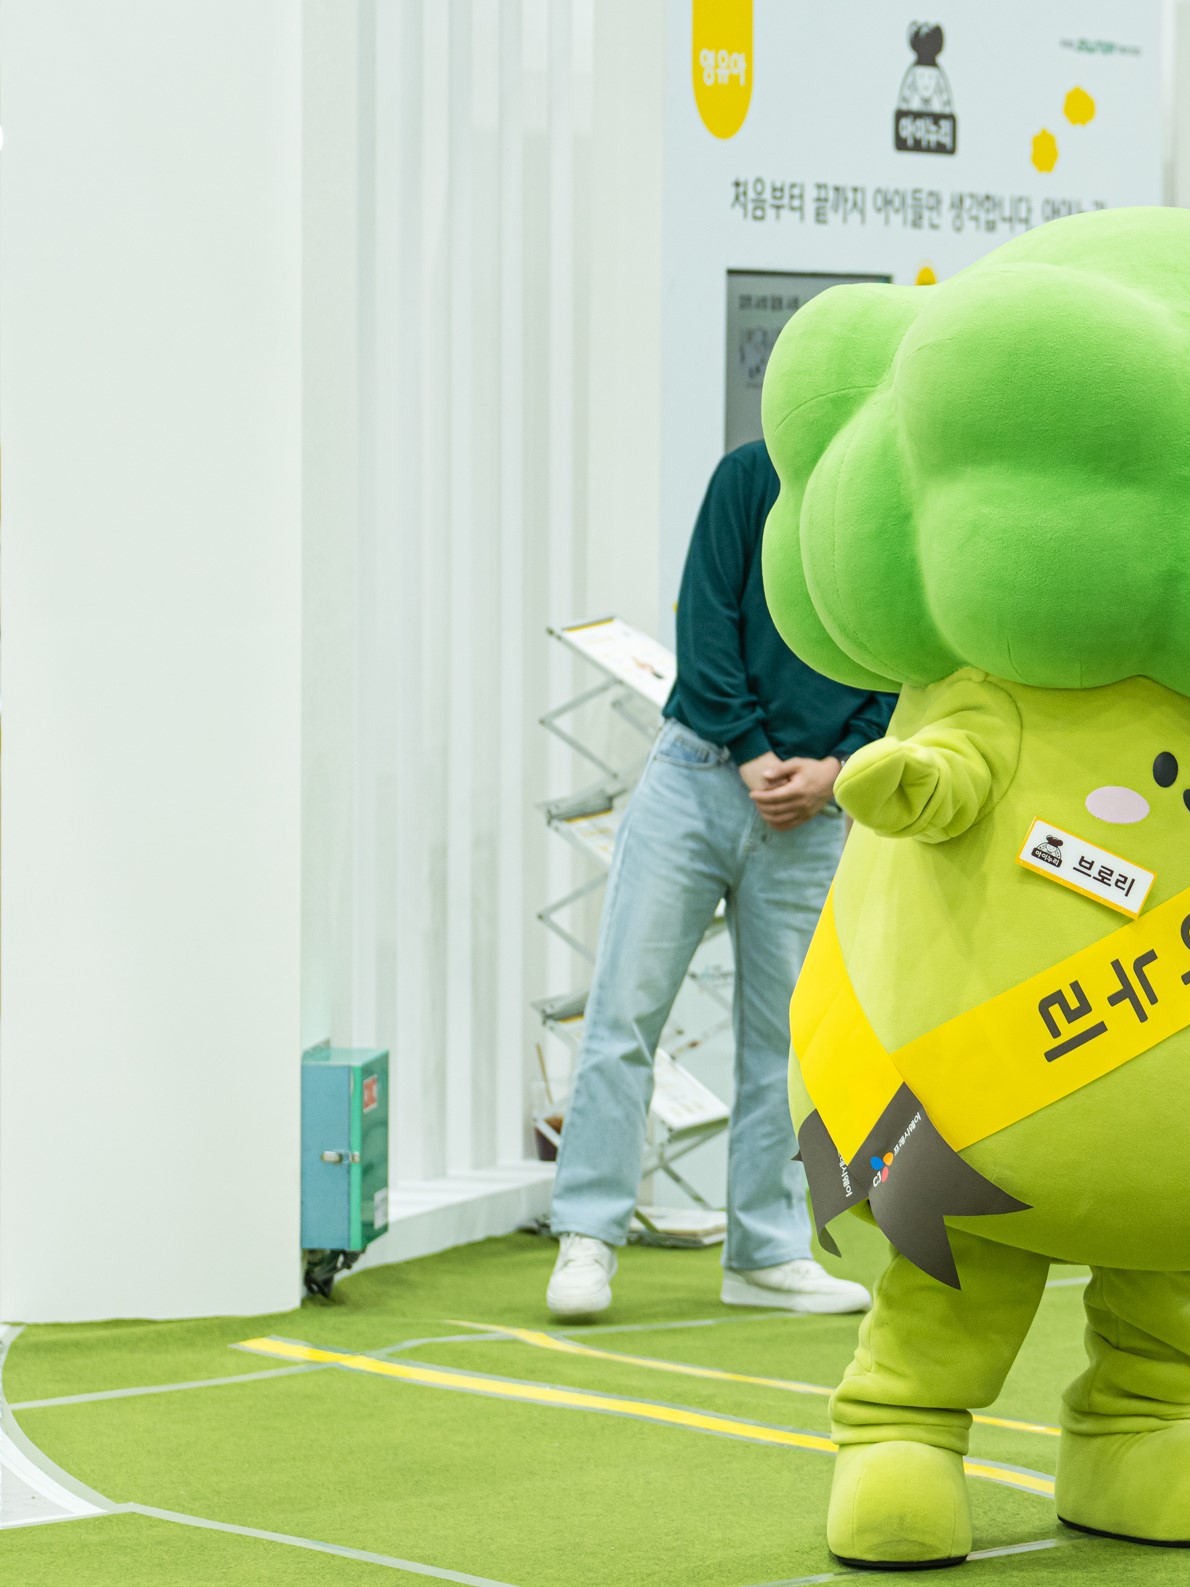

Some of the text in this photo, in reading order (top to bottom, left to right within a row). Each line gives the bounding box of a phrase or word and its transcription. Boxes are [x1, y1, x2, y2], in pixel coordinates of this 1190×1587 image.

[700, 48, 747, 87] 영유아
[899, 114, 954, 150] 아이누리
[731, 175, 805, 223] 처음부터
[813, 181, 867, 226] 끝까지
[872, 186, 943, 231] 아이들만
[1034, 849, 1136, 898] 아이누리 브로리
[872, 1111, 922, 1188] CJ 프레시웨이
